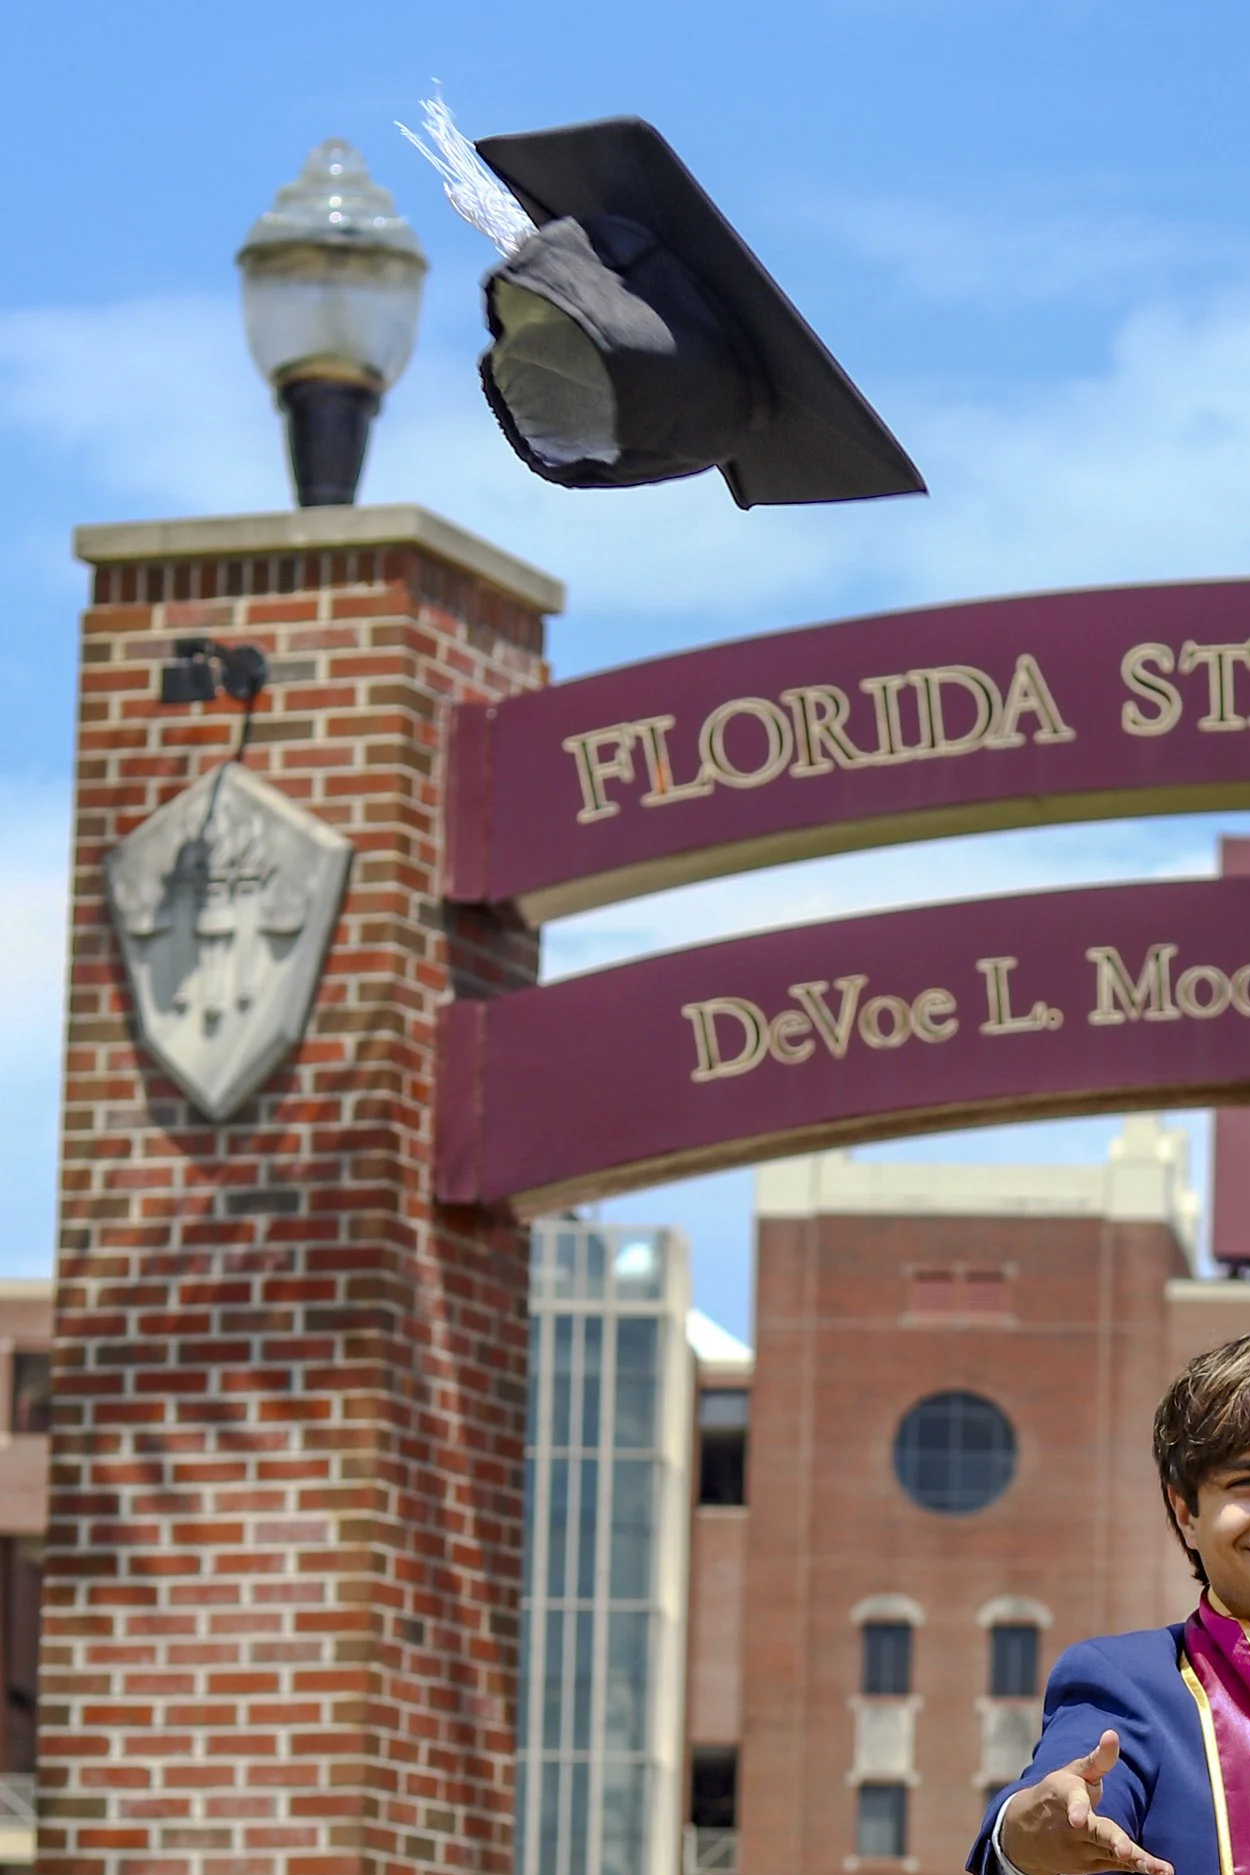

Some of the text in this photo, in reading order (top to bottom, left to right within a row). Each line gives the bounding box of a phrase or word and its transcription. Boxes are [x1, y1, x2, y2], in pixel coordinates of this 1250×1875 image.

[562, 654, 1076, 823] FLORIDA
[682, 974, 959, 1083] DeVoe
[976, 956, 1064, 1035] L.
